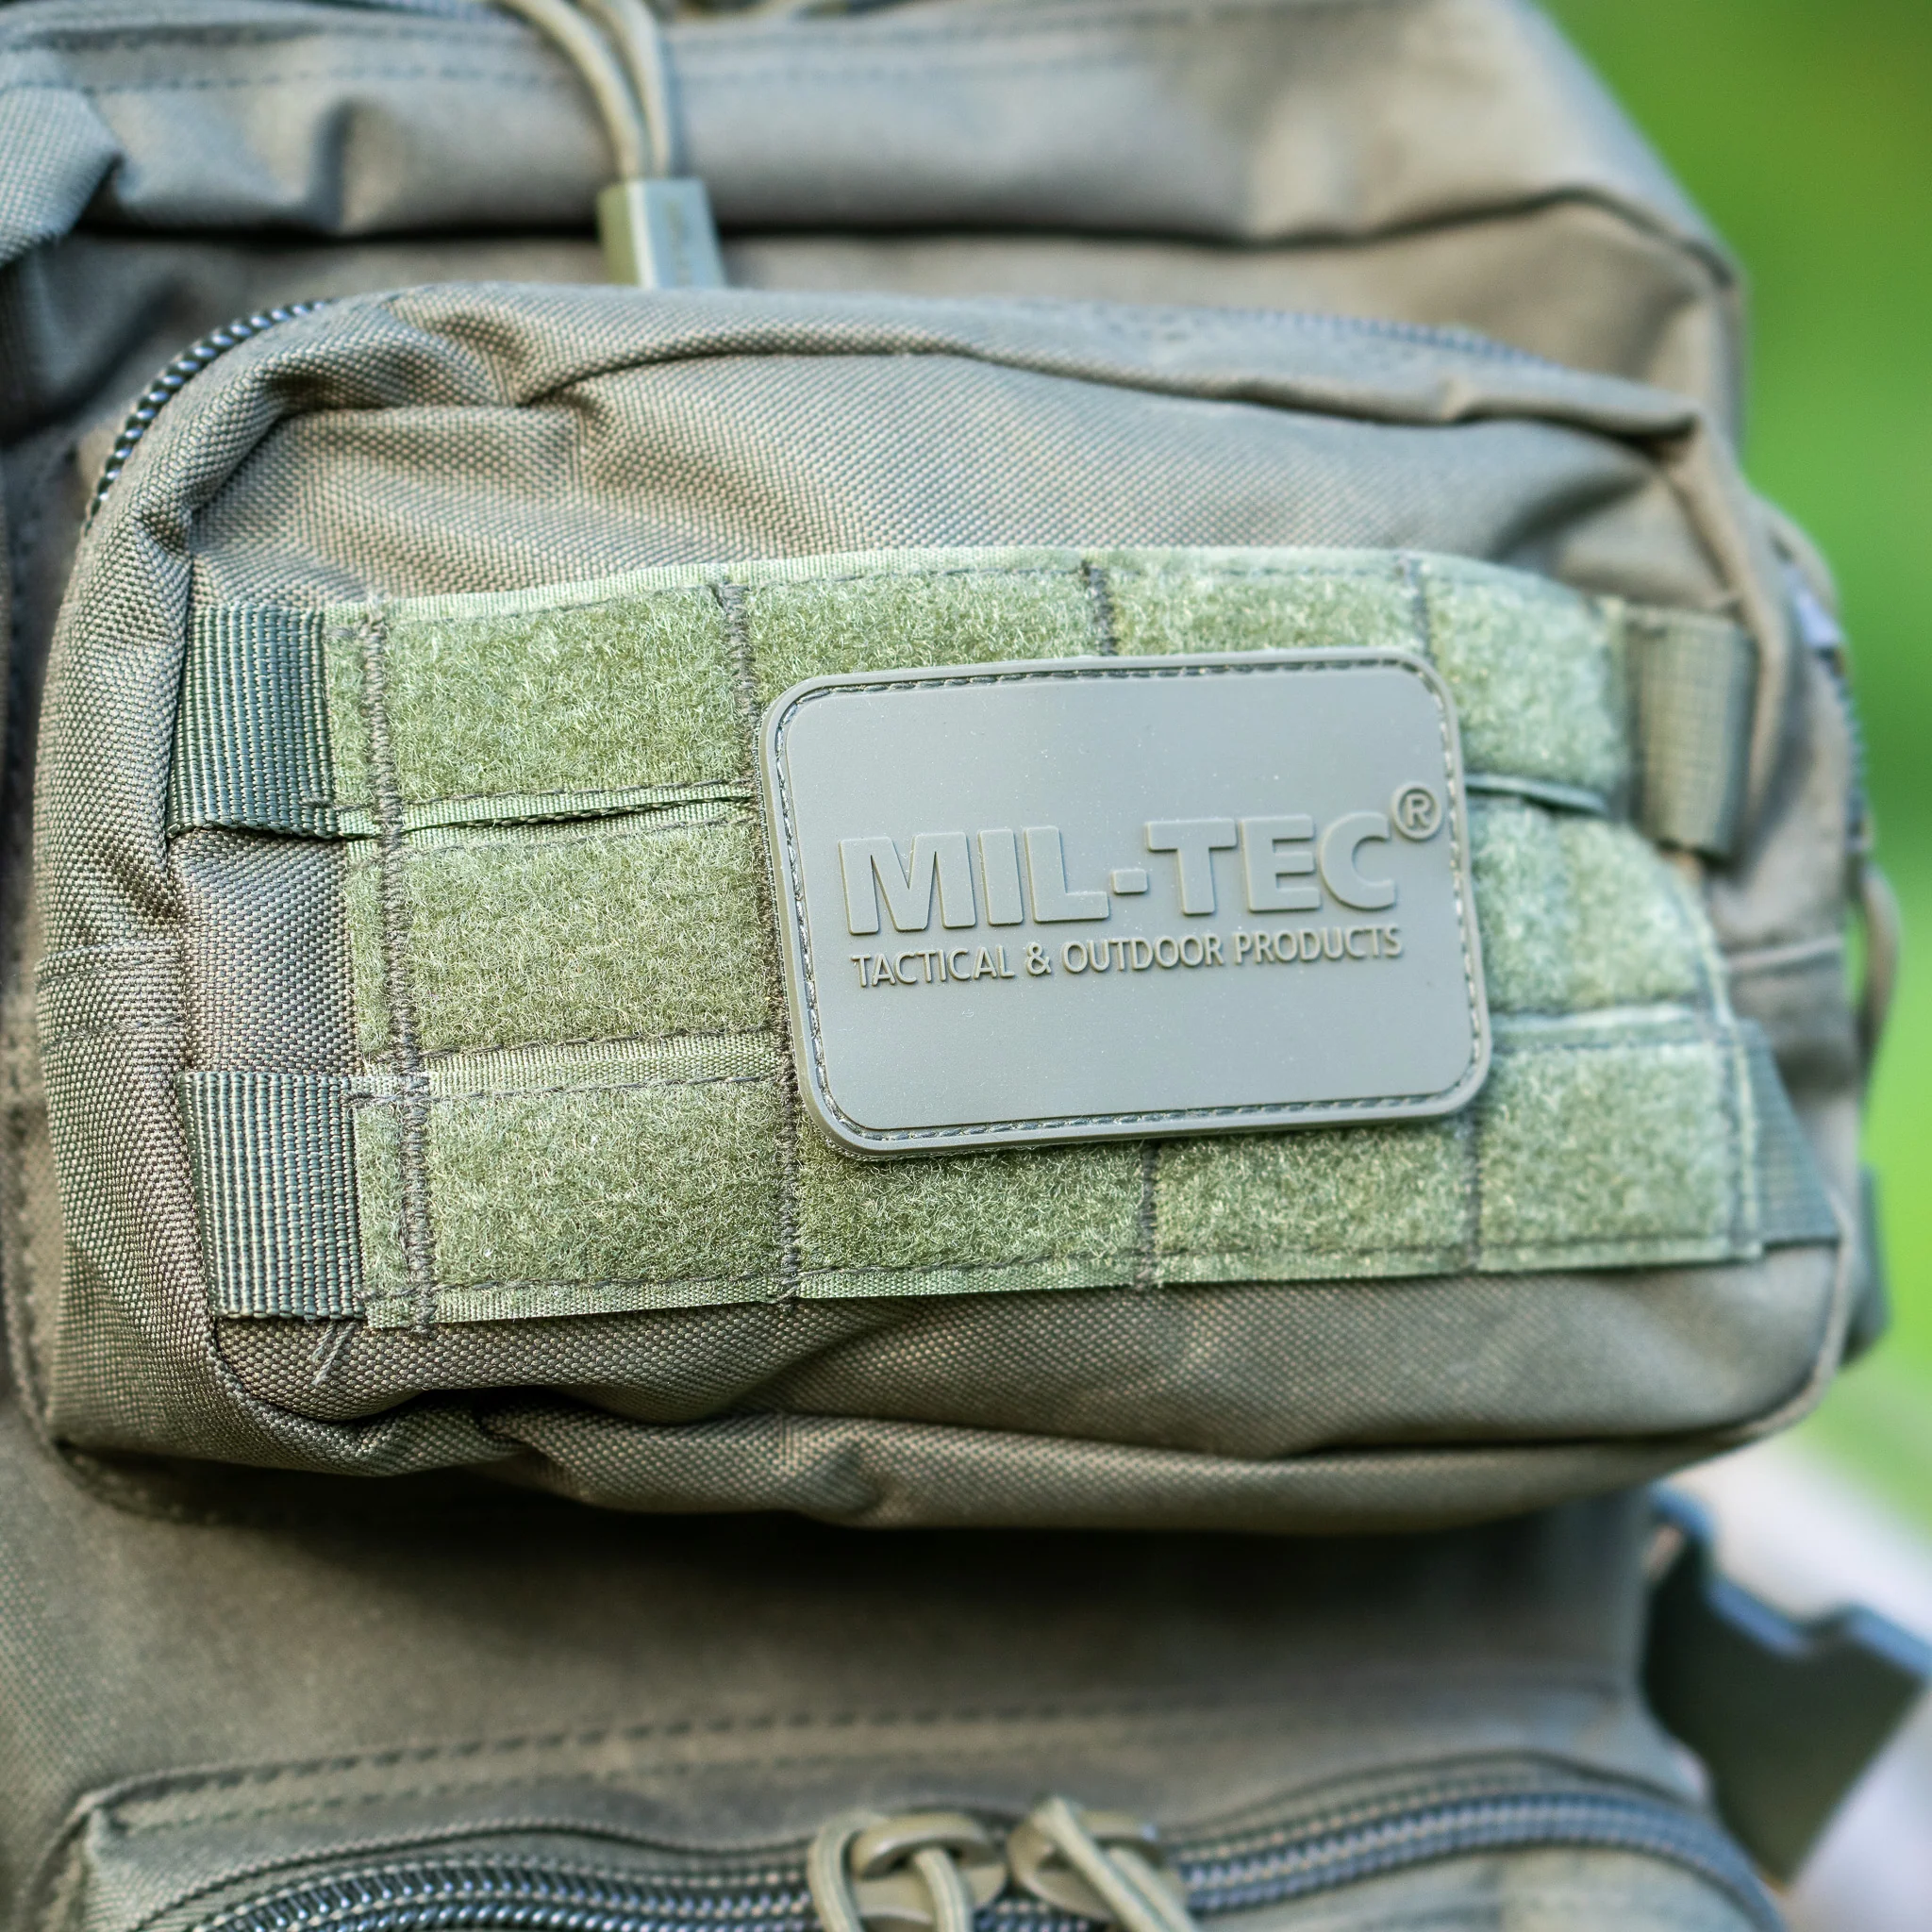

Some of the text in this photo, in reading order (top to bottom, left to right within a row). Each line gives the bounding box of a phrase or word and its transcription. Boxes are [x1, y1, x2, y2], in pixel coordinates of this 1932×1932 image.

[851, 924, 1404, 988] TACTICAL & OUTDOOR PRODUCTS
